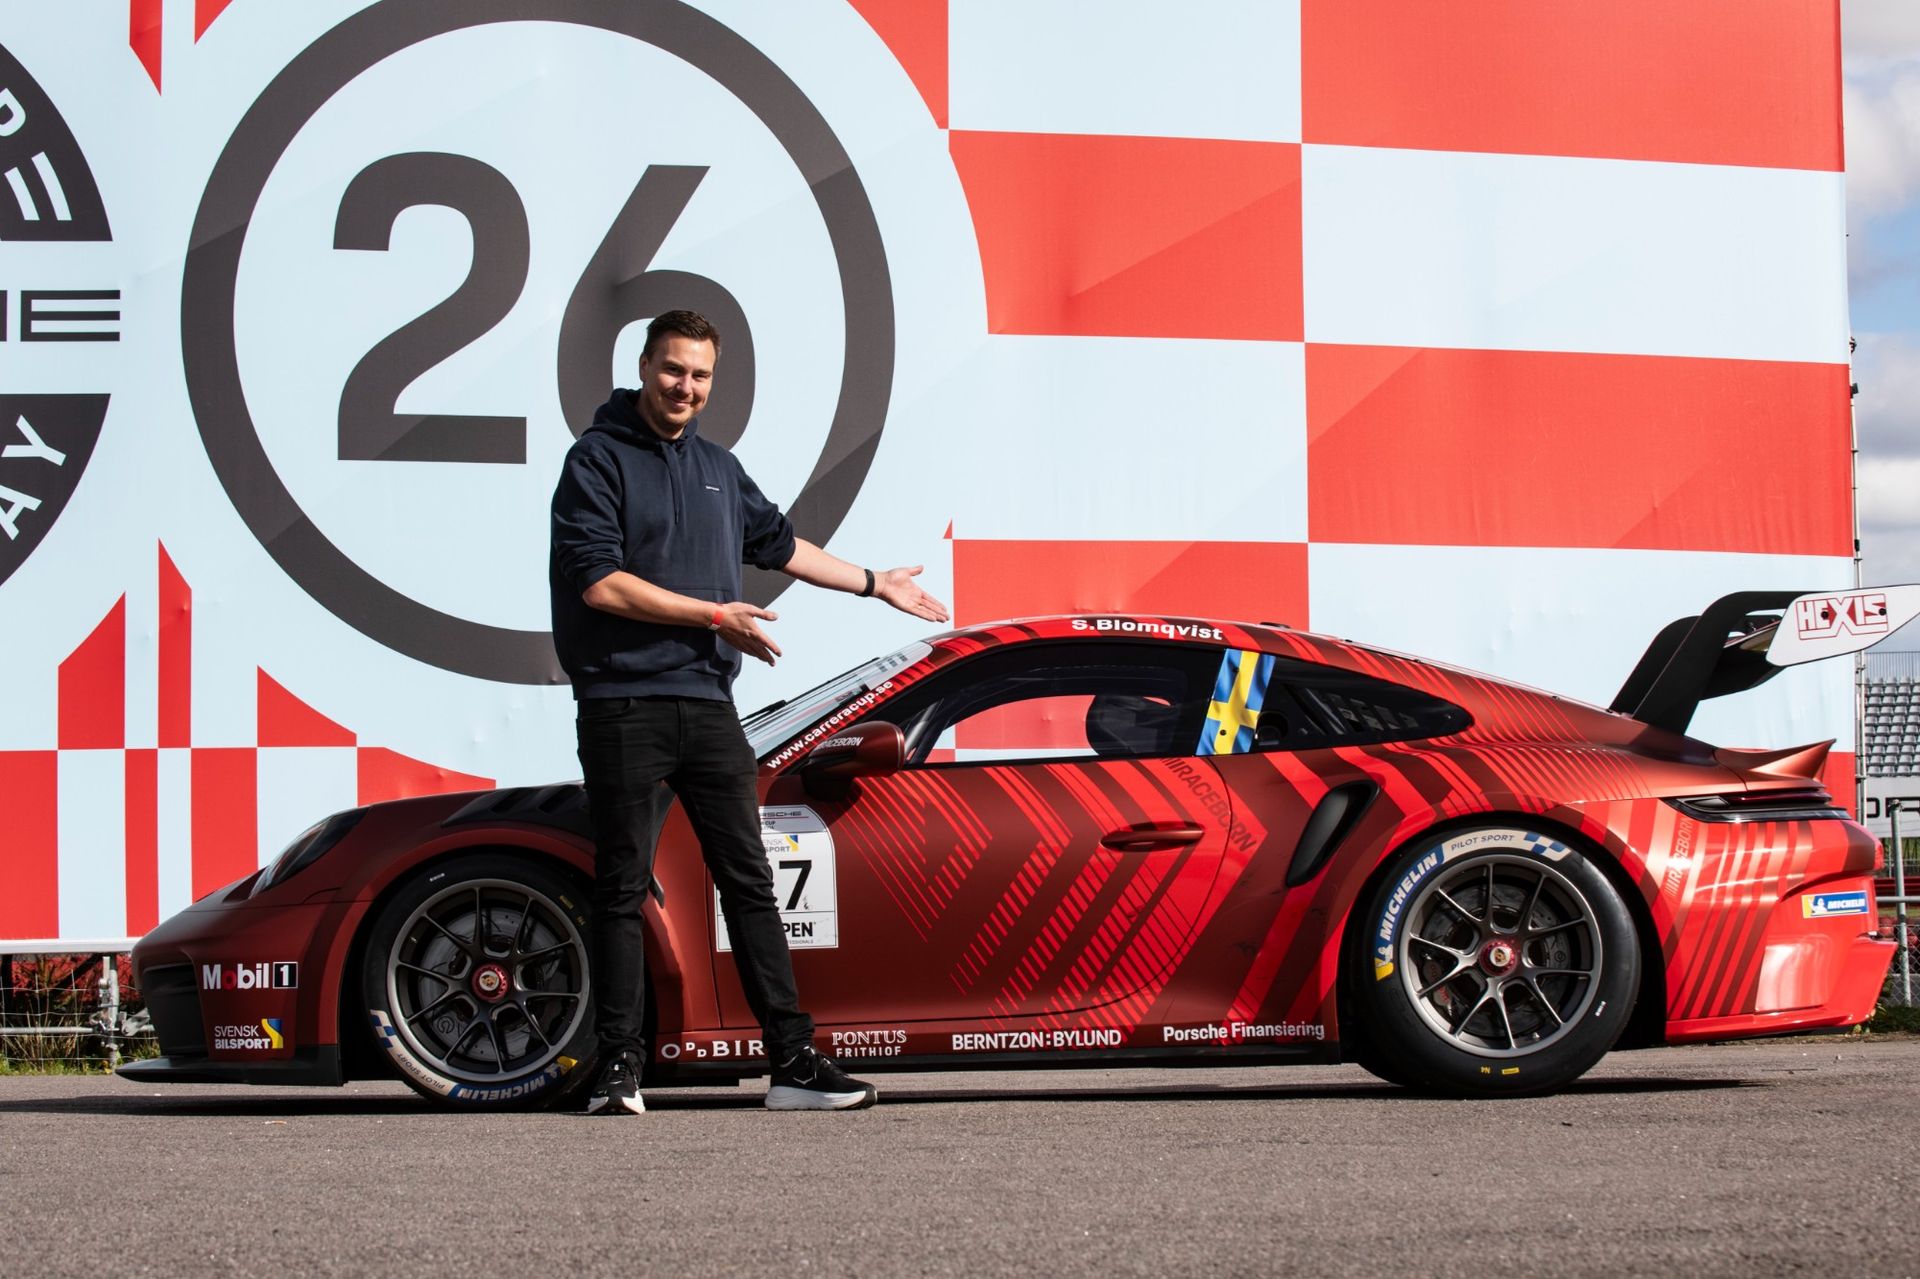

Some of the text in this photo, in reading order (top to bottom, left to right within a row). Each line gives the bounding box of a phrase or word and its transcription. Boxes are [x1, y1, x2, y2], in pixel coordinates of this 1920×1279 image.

[333, 151, 757, 465] 26
[1796, 593, 1890, 641] HEXIS
[1071, 618, 1223, 640] S.Blomqvist
[766, 681, 895, 769] www.carreracup.se
[1379, 834, 1515, 942] MICHELIN PILOT SPORT
[782, 922, 814, 938] PEN
[202, 963, 290, 990] Mobil 1
[214, 1025, 259, 1038] SVENSK
[832, 1030, 908, 1046] PONTUS
[1163, 1021, 1325, 1042] Porsche Finansiering
[215, 1038, 271, 1050] BILSPORT
[836, 1046, 902, 1058] FRITHIOF
[420, 1074, 446, 1089] PILOT
[458, 1074, 546, 1100] MICHELIN
